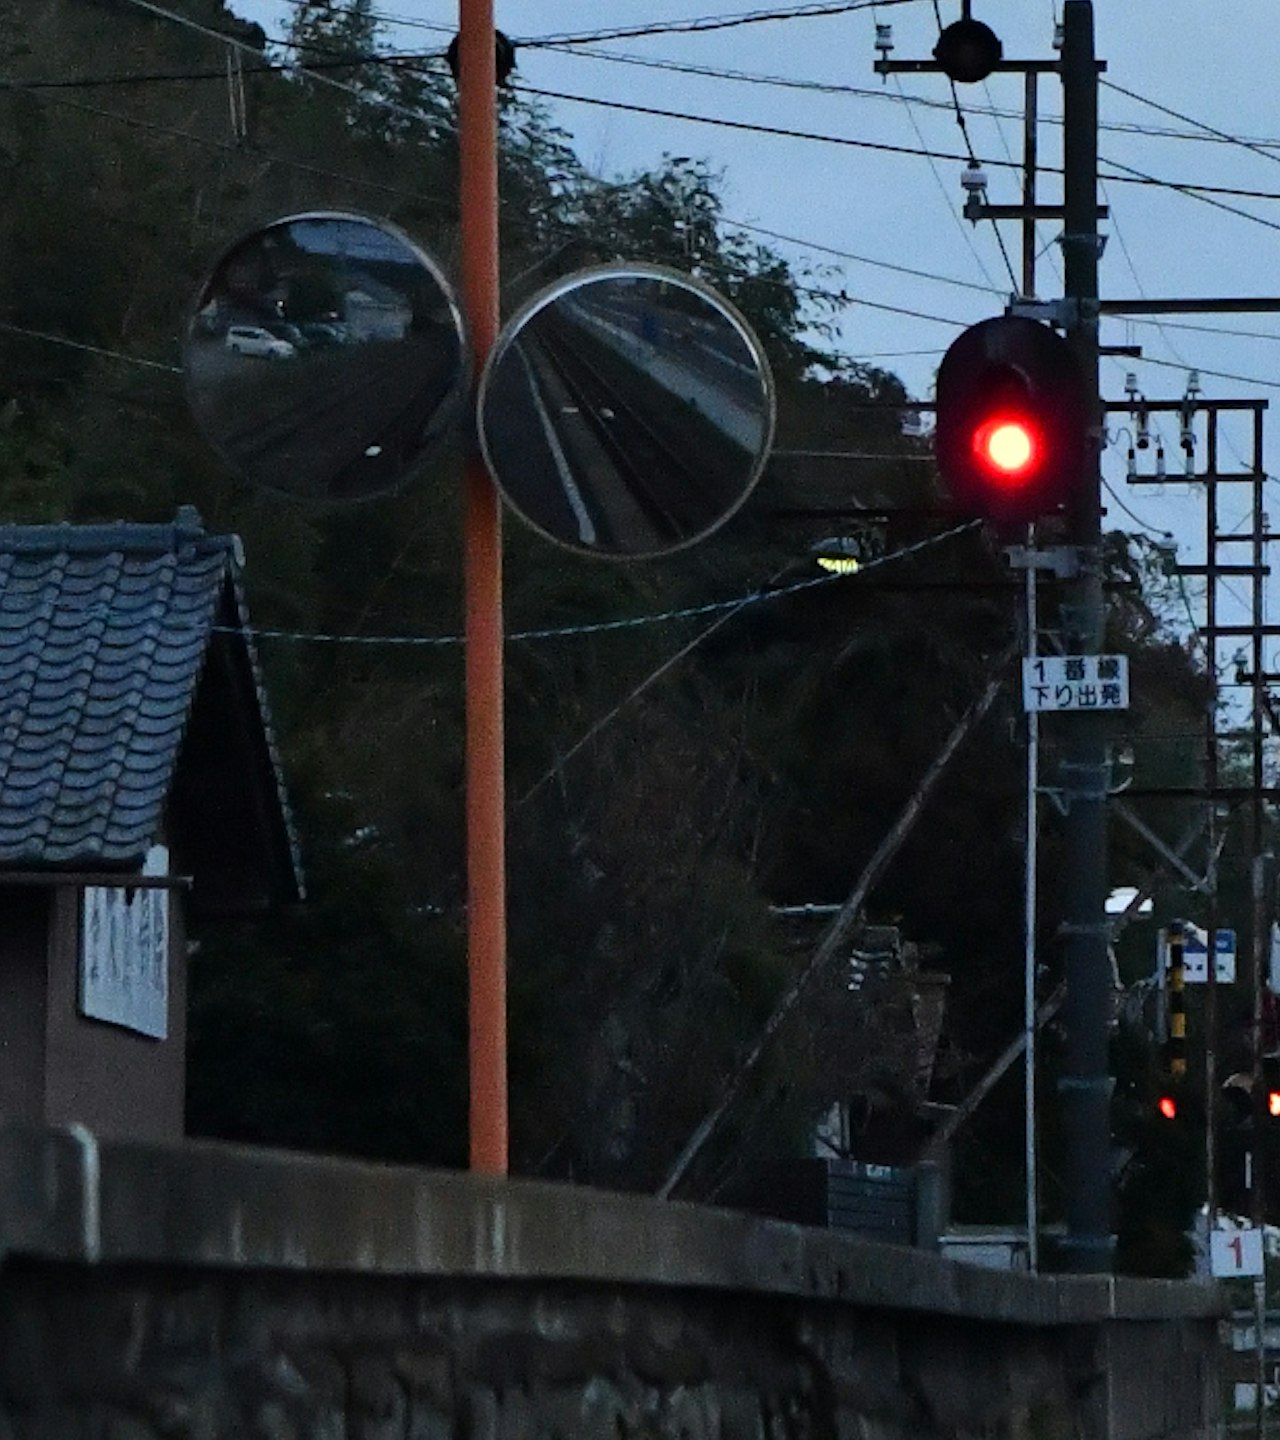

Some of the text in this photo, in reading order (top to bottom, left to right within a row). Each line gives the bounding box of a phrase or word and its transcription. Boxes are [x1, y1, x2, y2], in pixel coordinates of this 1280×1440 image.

[1030, 684, 1121, 707] 下り出発
[1228, 1237, 1243, 1269] 1
